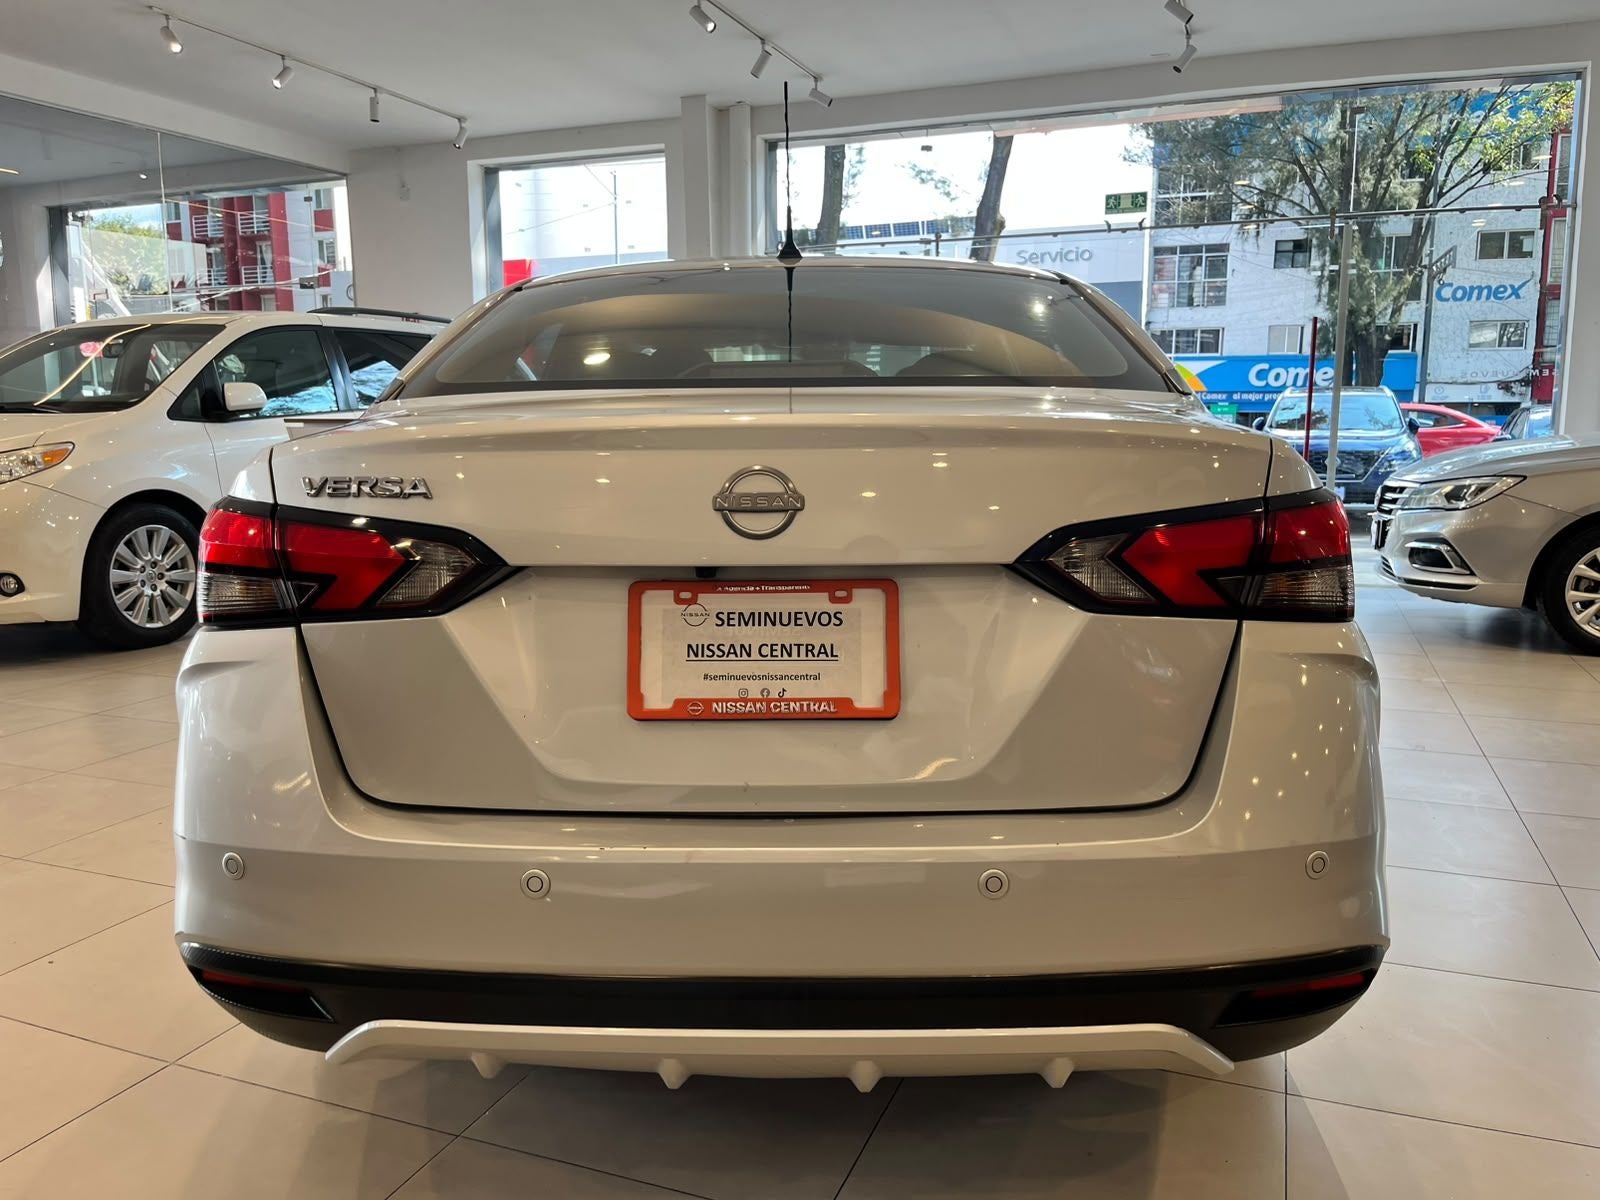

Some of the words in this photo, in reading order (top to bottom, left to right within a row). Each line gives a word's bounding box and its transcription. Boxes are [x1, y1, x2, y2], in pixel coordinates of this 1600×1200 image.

[1016, 247, 1094, 265] Servicio
[1435, 271, 1535, 302] Comex
[1248, 362, 1334, 388] Come
[301, 476, 433, 499] VERSA
[716, 495, 801, 507] NISSAN
[715, 611, 844, 628] SEMINUEVOS
[686, 643, 752, 659] NISSAN
[758, 643, 839, 659] CENTRAL
[703, 672, 821, 682] #seminuevosnissancentral
[712, 702, 767, 714] NISSAN
[770, 701, 838, 714] CENTRAL
